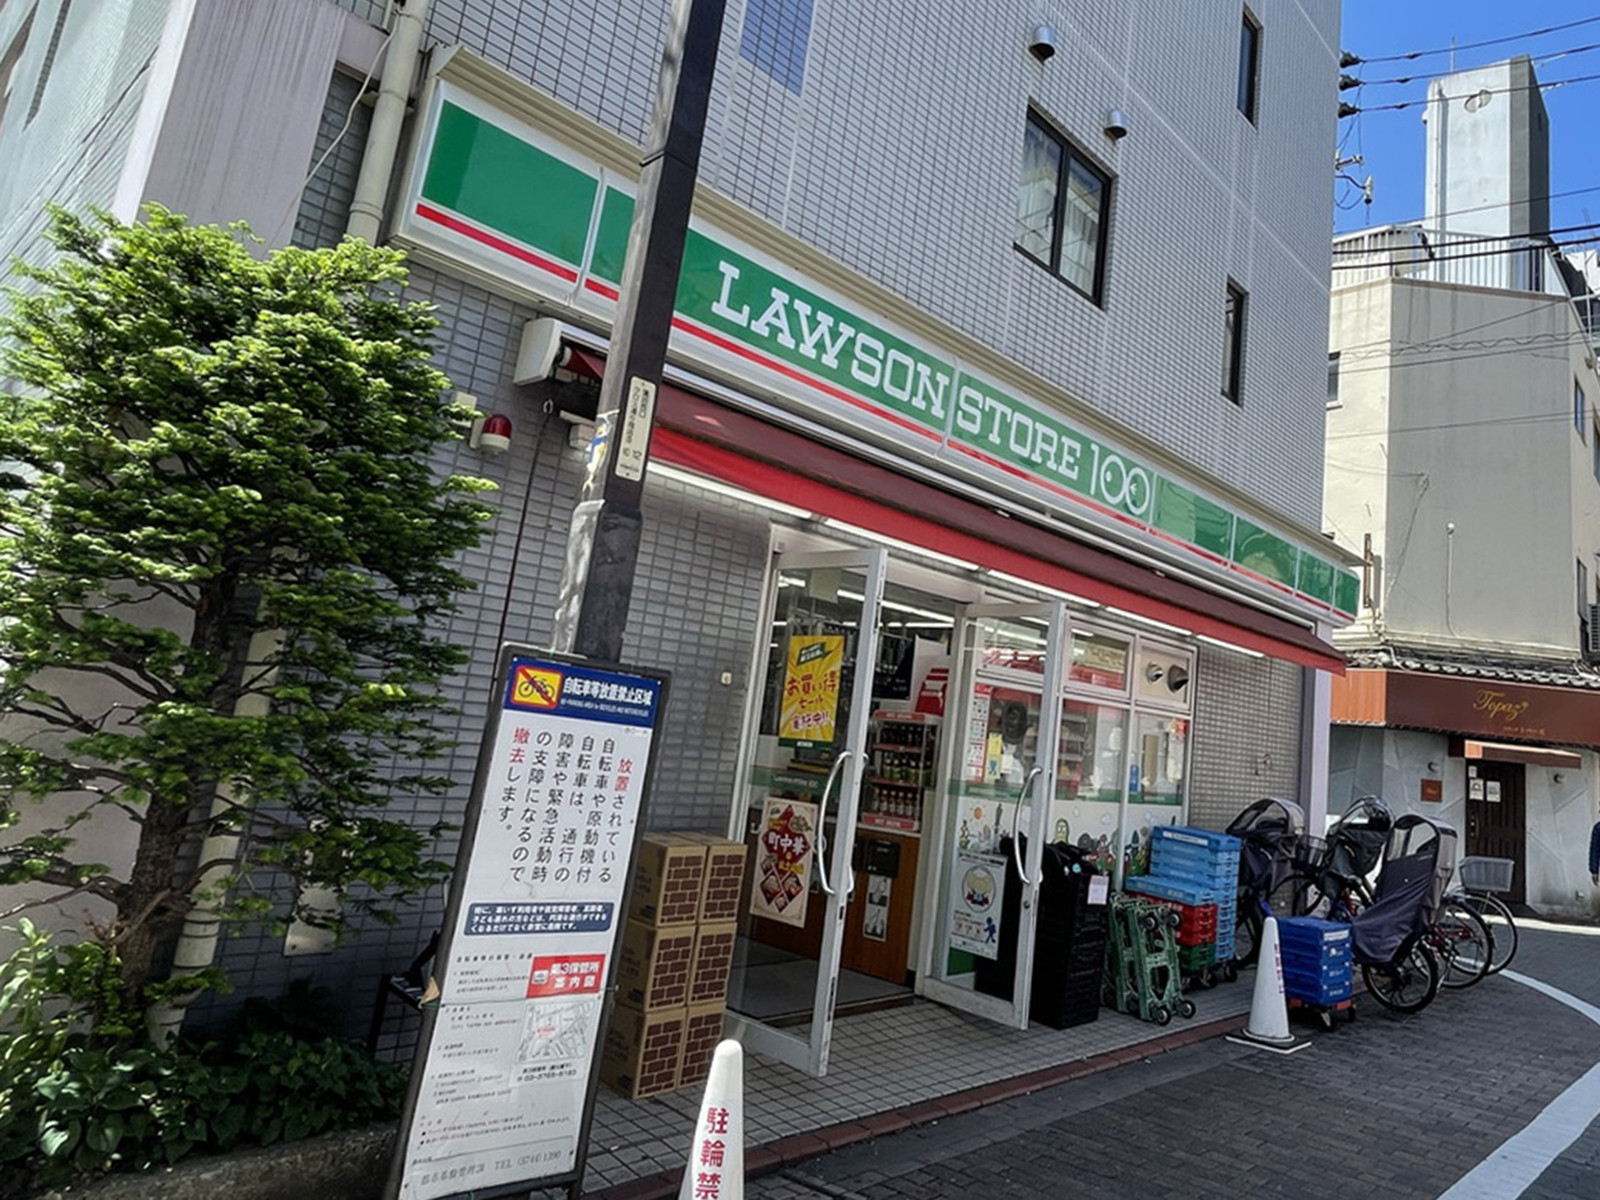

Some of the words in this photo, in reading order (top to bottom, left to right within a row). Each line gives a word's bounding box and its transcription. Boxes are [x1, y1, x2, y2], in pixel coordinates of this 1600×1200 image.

[711, 260, 950, 419] LAWSON
[957, 385, 1081, 480] STORE
[1090, 443, 1150, 515] 100
[498, 726, 531, 831] 撤去します。
[510, 731, 552, 882] の支障になるので
[531, 732, 574, 883] 障害や緊急活動時
[577, 738, 615, 883] 自転車や原動機付
[599, 758, 634, 883] 放置されている
